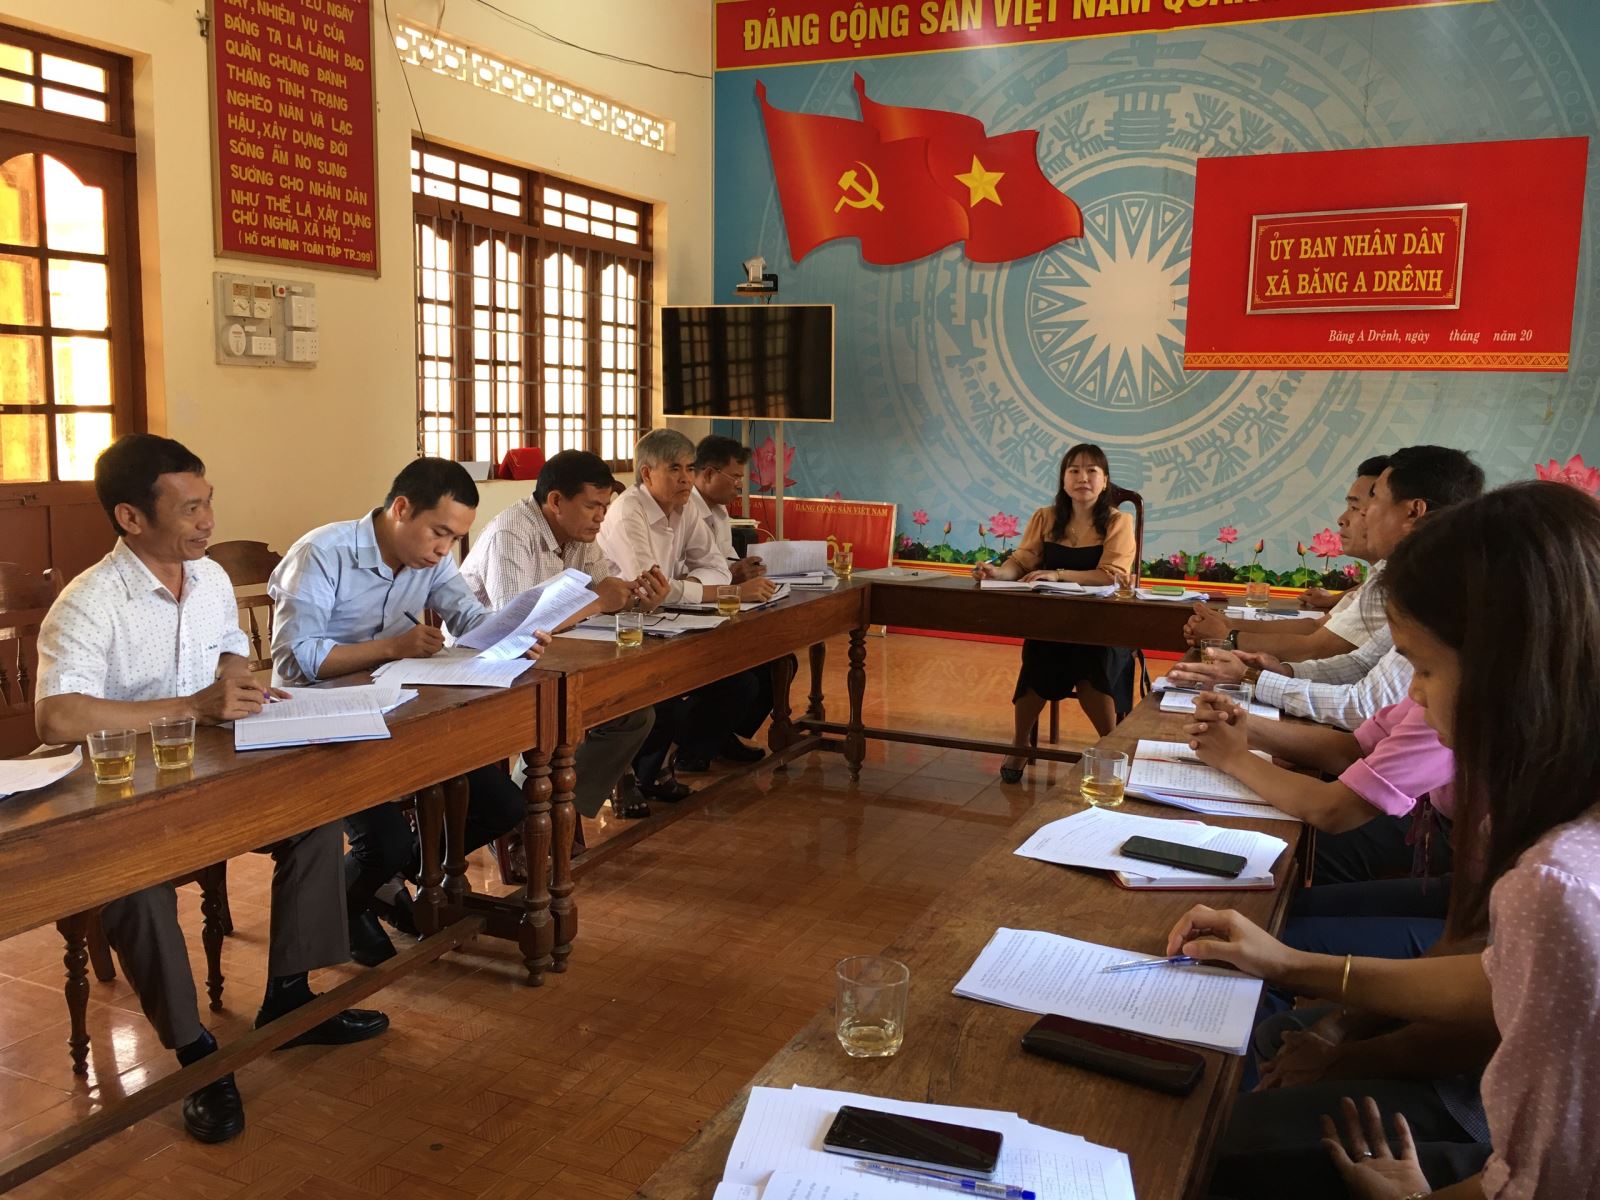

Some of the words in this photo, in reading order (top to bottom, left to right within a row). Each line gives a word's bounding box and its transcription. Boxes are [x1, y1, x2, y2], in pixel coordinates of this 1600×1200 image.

[301, 15, 318, 35] VỤ
[744, 8, 820, 50] ĐẢNG
[830, 2, 909, 48] CỘNG
[266, 27, 282, 46] TA
[310, 88, 348, 112] TRẠNG
[295, 154, 311, 170] NO
[317, 160, 347, 179] SUNG
[279, 175, 304, 192] CHO
[231, 189, 260, 207] NHƯ
[278, 237, 299, 251] MINH
[1269, 230, 1295, 261] ỦY
[1299, 236, 1337, 260] BAN
[1342, 229, 1397, 258] NHÂN
[1402, 226, 1446, 256] DÂN
[1264, 268, 1291, 297] XÃ
[1296, 266, 1349, 294] BĂNG
[1353, 270, 1368, 293] A
[1372, 264, 1443, 293] DRÊNH
[1328, 329, 1355, 344] Băng
[1356, 330, 1365, 342] A
[1367, 329, 1401, 343] Drênh,
[1405, 330, 1430, 344] ngày
[1449, 329, 1480, 344] tháng
[1493, 329, 1517, 342] năm
[1519, 330, 1533, 341] 20
